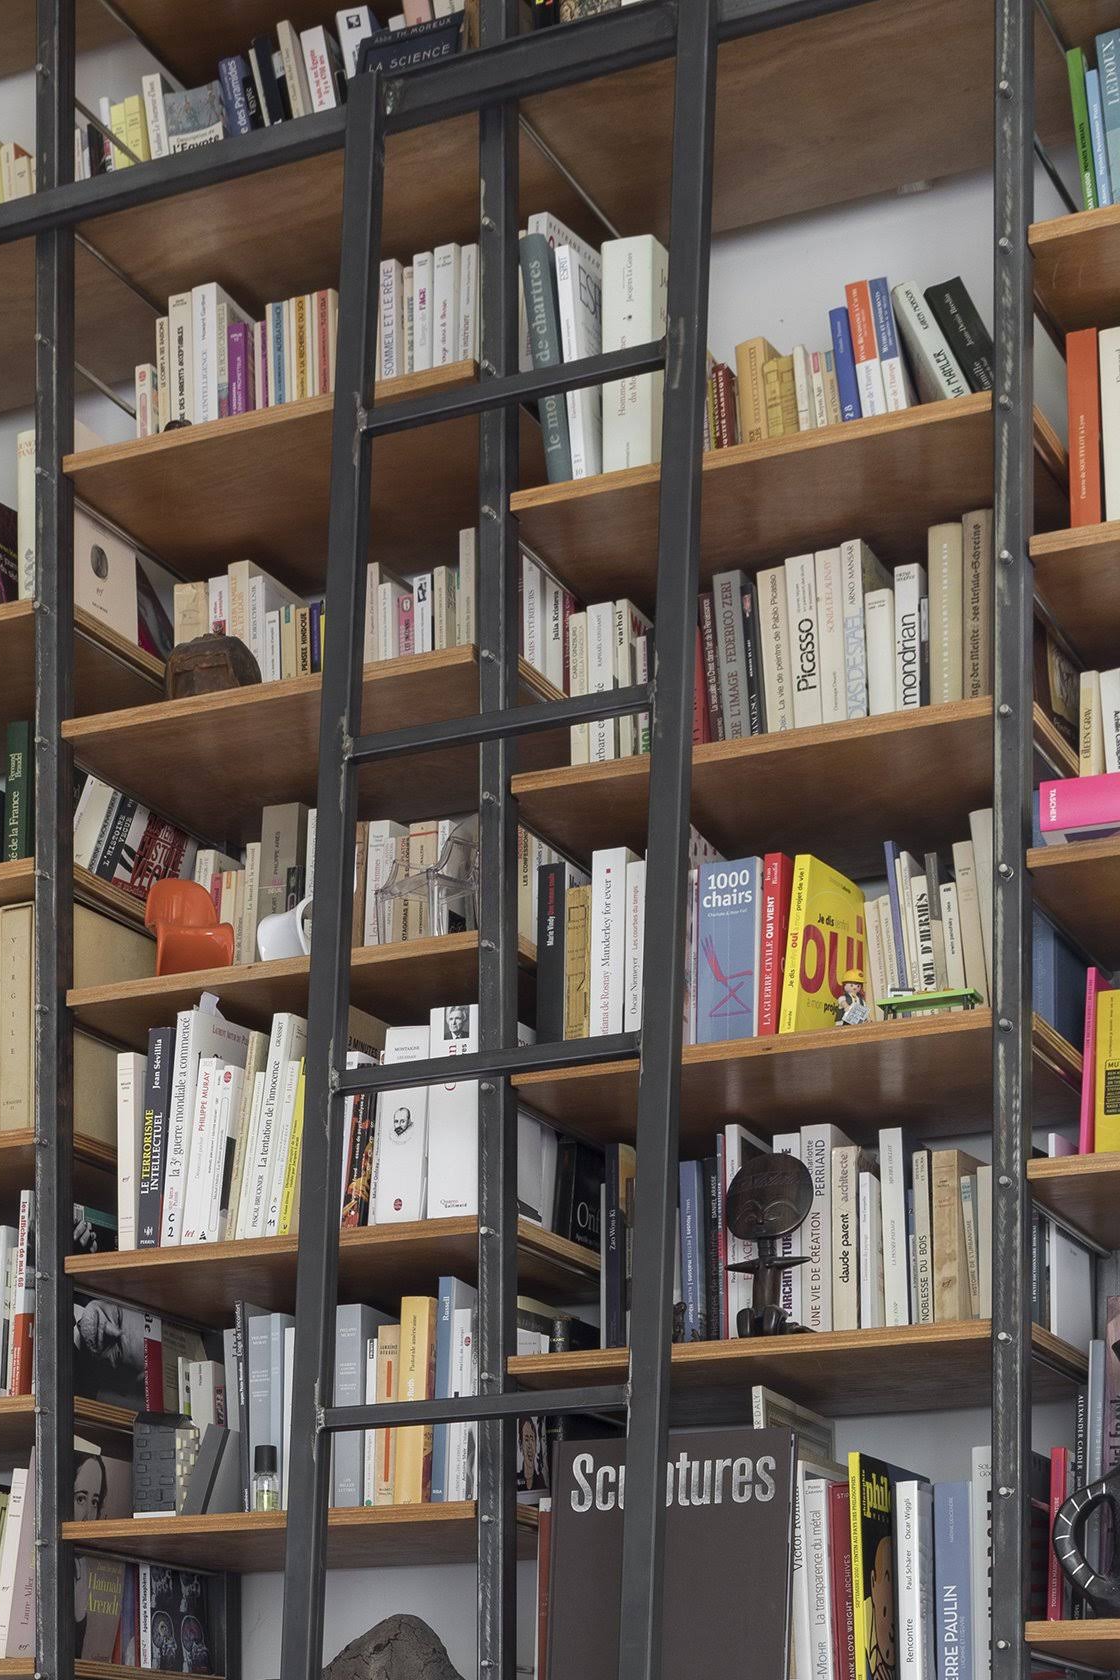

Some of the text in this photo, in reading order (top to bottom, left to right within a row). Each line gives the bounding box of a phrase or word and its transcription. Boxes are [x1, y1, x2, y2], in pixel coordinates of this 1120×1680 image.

[368, 42, 451, 73] LA SCIENCE
[228, 60, 245, 109] Pyramides
[381, 267, 394, 375] SOMMEIL ET LE RÊVE
[527, 260, 551, 362] de chartres
[844, 403, 854, 418] 28
[720, 581, 732, 607] ZERI
[616, 610, 624, 646] warhol
[723, 610, 737, 664] FEDERICO
[796, 618, 817, 693] Picasso
[898, 613, 917, 705] mondrian
[9, 791, 20, 851] de la France
[703, 888, 752, 908] chairs
[708, 870, 750, 889] 1000
[766, 925, 775, 939] QUI
[767, 896, 776, 923] VIENT
[915, 893, 932, 954] D'HERMÈS
[765, 940, 773, 971] CIVILE
[789, 932, 799, 948] oui
[764, 973, 772, 1010] GUERRE
[152, 1039, 163, 1089] Jean Sévillia
[179, 1017, 190, 1069] commencé
[175, 1079, 186, 1122] mondiale
[198, 1071, 210, 1131] PHILIPPE MURAY
[257, 1060, 280, 1168] La tentation de l'innocence
[141, 1109, 154, 1194] LE TERRORISME
[150, 1112, 163, 1191] INTELLECTUEL
[173, 1125, 185, 1155] guerre
[168, 1168, 180, 1177] la
[815, 1140, 825, 1197] PERRIAND
[251, 1174, 264, 1227] PASCAL BRUCKNER
[837, 1154, 852, 1283] claude parent architecte
[807, 1212, 822, 1327] UNE VIE DE CRÉATION
[918, 1235, 929, 1321] NOBLESSE DU BOIS
[442, 1296, 450, 1321] Russell
[570, 1452, 776, 1513] Sctures
[88, 1571, 122, 1595] Hannah
[808, 1509, 827, 1626] La transparence du métal
[843, 1554, 852, 1593] ARCHIVES
[905, 1577, 913, 1590] Paul
[87, 1592, 121, 1615] Arendt
[846, 1601, 854, 1631] WRIGHT
[944, 1585, 959, 1642] PAULIN
[847, 1633, 855, 1660] LLOYD
[905, 1618, 914, 1663] Rencontre
